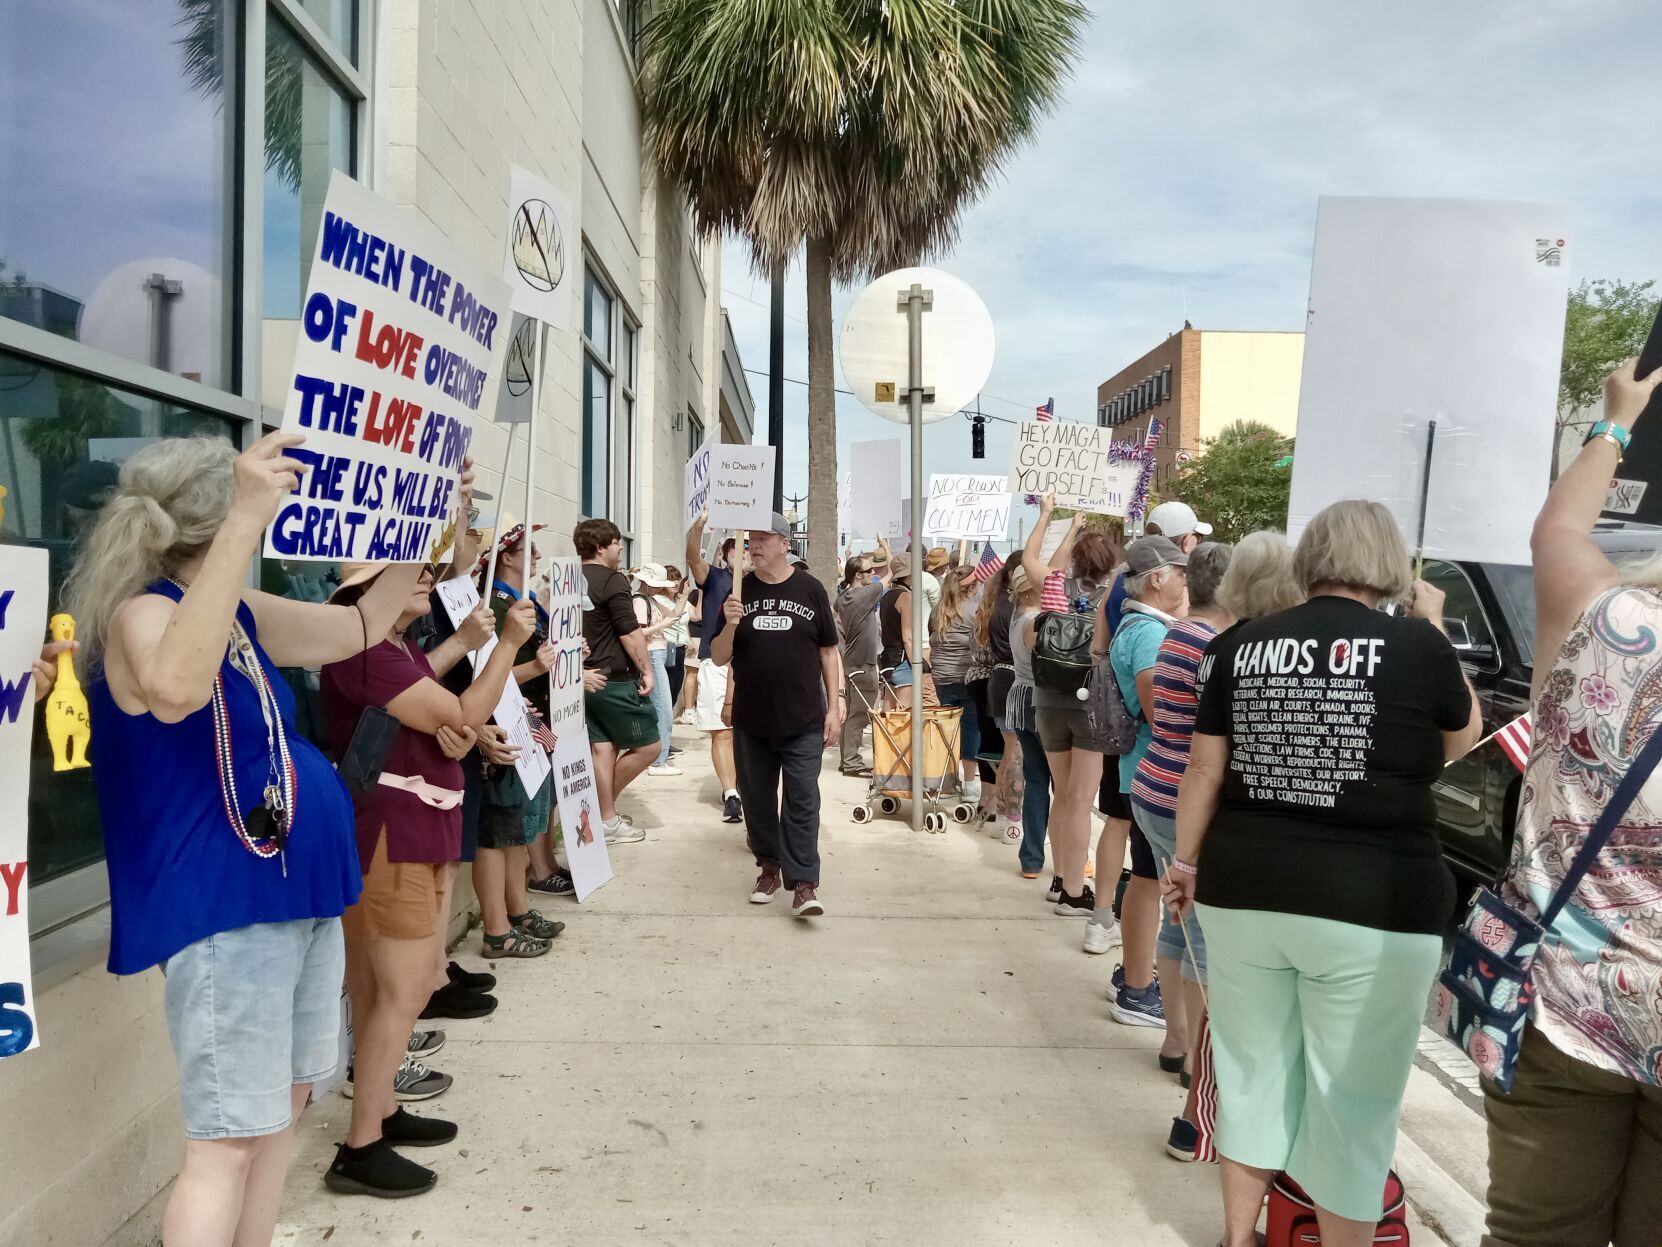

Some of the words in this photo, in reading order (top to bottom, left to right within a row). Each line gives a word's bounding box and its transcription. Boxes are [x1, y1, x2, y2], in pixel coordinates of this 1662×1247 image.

[320, 210, 405, 293] WHEN
[409, 254, 451, 318] THE
[448, 282, 498, 352] POWER
[303, 292, 357, 353] OF
[355, 309, 424, 380] LOVE
[294, 373, 365, 437] THE
[362, 390, 423, 454] LOVE
[418, 411, 446, 464] OF
[1020, 421, 1050, 444] HEY,
[1053, 424, 1100, 448] MAGA
[721, 460, 731, 470] No
[1020, 443, 1052, 467] GO
[1055, 447, 1106, 472] FACT
[693, 450, 710, 488] NO
[281, 447, 351, 502] THE
[352, 461, 388, 511] U.S.
[390, 467, 429, 518] WILL
[428, 475, 454, 521] BE
[717, 479, 725, 487] No
[932, 478, 955, 495] NO
[1016, 466, 1103, 497] YOURSELF
[714, 498, 723, 506] No
[271, 502, 367, 558] GREAT
[365, 515, 432, 562] AGAIN!
[742, 600, 760, 617] ULF
[762, 599, 776, 610] OF
[778, 599, 815, 621] MEXICO
[757, 617, 788, 629] 1550
[1232, 638, 1319, 677] HANDS
[1328, 638, 1385, 677] OFF
[1239, 677, 1265, 688] MEDICARE,
[1267, 677, 1300, 688] MEDICAID,
[1302, 678, 1326, 687] SOCIAL
[1329, 678, 1368, 691] SECURITY,
[1261, 689, 1286, 698] CANCER
[1287, 689, 1324, 700] RESEARCH,
[1326, 689, 1375, 702] IMMIGRANTS,
[1249, 701, 1268, 710] CLEAN
[1269, 701, 1282, 711] AIR,
[1284, 701, 1313, 712] COURTS,
[1315, 702, 1348, 713] CANADA,
[1350, 703, 1377, 715] BOOKS,
[1248, 712, 1270, 722] RIGHTS,
[1271, 712, 1292, 721] CLEAN
[1293, 712, 1321, 724] ENERGY,
[1323, 713, 1356, 725] UKRAINE,
[1359, 715, 1373, 726] IVF,
[1251, 723, 1282, 732] CONSUMER
[1284, 723, 1332, 736] PROTECTIONS,
[1334, 726, 1369, 738] PANAMA,
[1289, 735, 1323, 747] FARMERS,
[1325, 736, 1340, 747] THE
[1341, 737, 1375, 750] ELDERLY,
[1253, 754, 1286, 766] WORKERS,
[1287, 756, 1336, 769] REPRODUCTIVE
[1276, 745, 1293, 755] LAW
[1319, 748, 1336, 759] CDC,
[1338, 749, 1352, 759] THE
[1355, 750, 1367, 761] VA,
[562, 765, 571, 781] NO
[570, 759, 586, 777] KINGS
[1245, 763, 1270, 776] WATER,
[1271, 765, 1314, 779] UNIVERSITIES,
[1316, 769, 1331, 779] OUR
[1333, 770, 1368, 781] HISTORY,
[562, 784, 569, 799] IN
[570, 775, 592, 796] AMERICA
[1242, 773, 1259, 786] FREE
[1260, 775, 1290, 789] SPEECH,
[1292, 778, 1344, 795] DEMOCRACY,
[1248, 787, 1255, 799] &
[1257, 788, 1274, 800] OUR
[1276, 790, 1335, 807] CONSTITUTION
